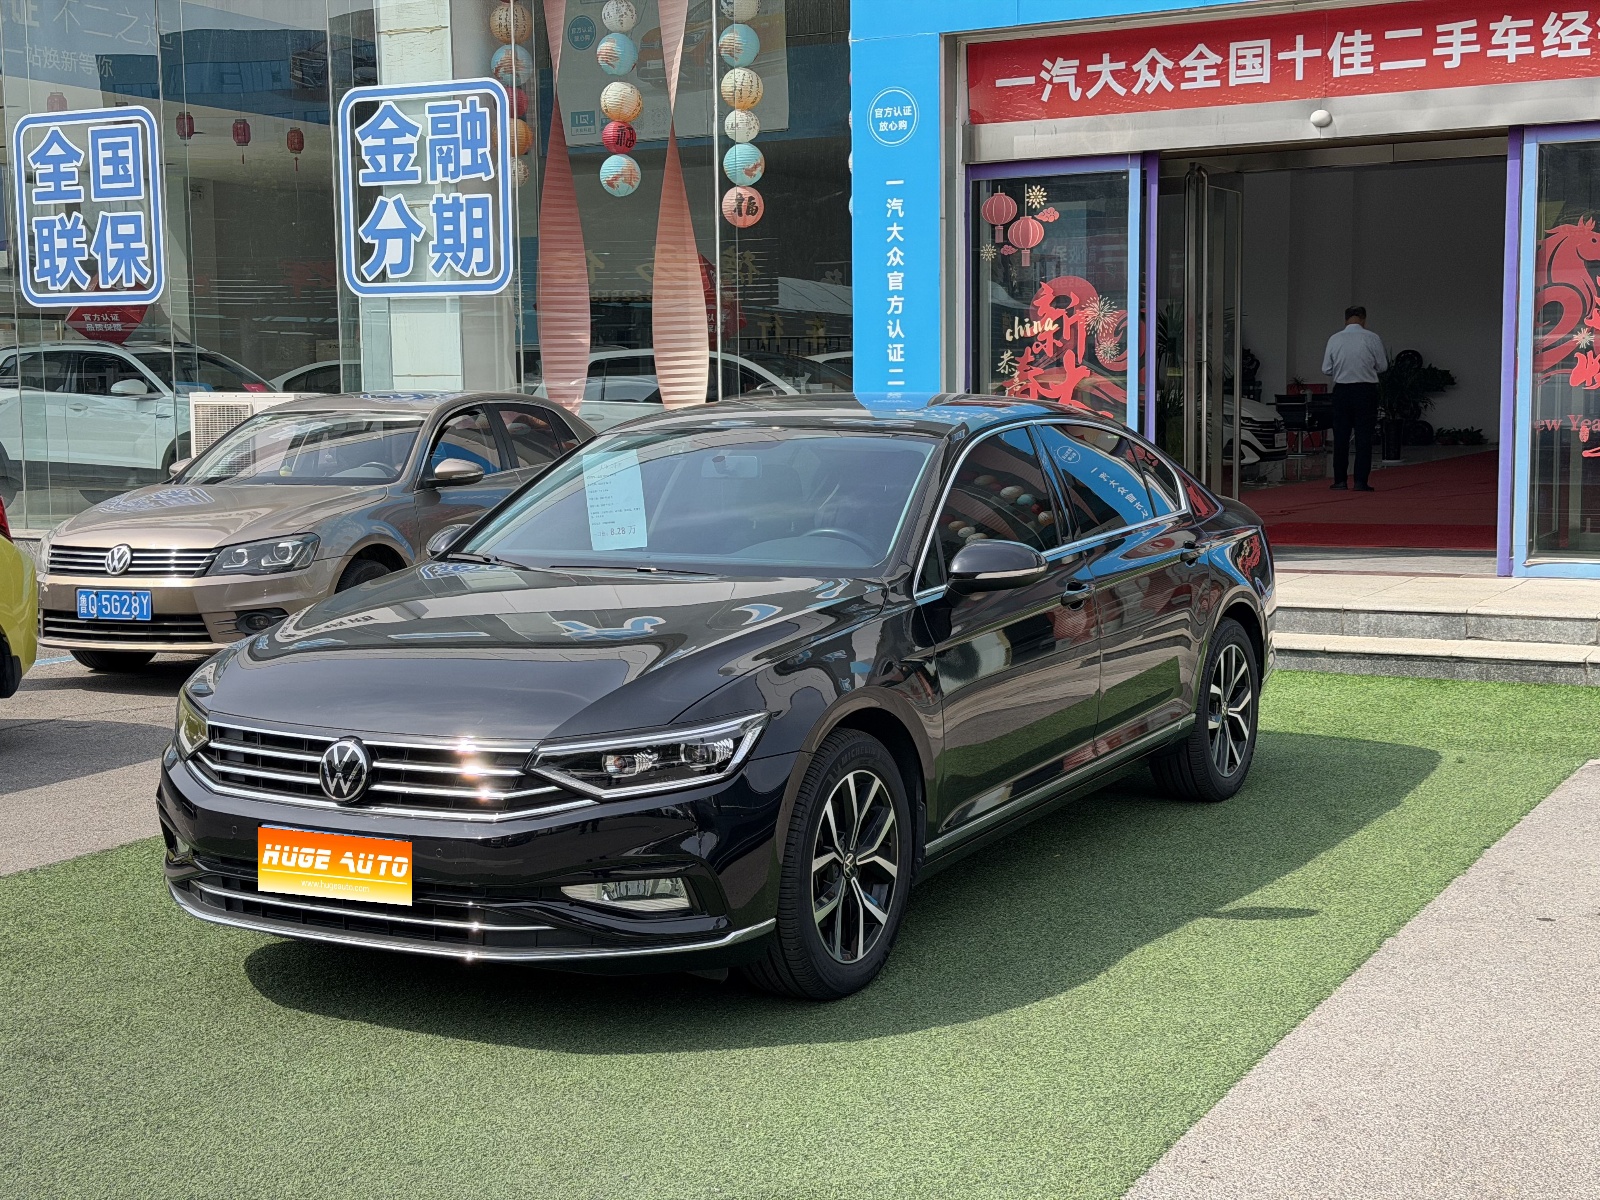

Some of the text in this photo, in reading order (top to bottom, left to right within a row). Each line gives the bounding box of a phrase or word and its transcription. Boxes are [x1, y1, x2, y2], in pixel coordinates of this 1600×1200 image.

[996, 10, 1600, 102] 一汽大众全国十佳二手车经
[356, 98, 495, 186] 金融
[874, 106, 913, 119] 官方认证
[879, 120, 908, 132] 放心购
[29, 126, 144, 204] 全国
[34, 212, 151, 289] 联保
[359, 194, 493, 281] 分期
[886, 179, 905, 386] 一汽大众官方认证二
[1005, 315, 1058, 342] china
[996, 349, 1026, 397] 恭喜
[1534, 414, 1600, 432] ew Yea
